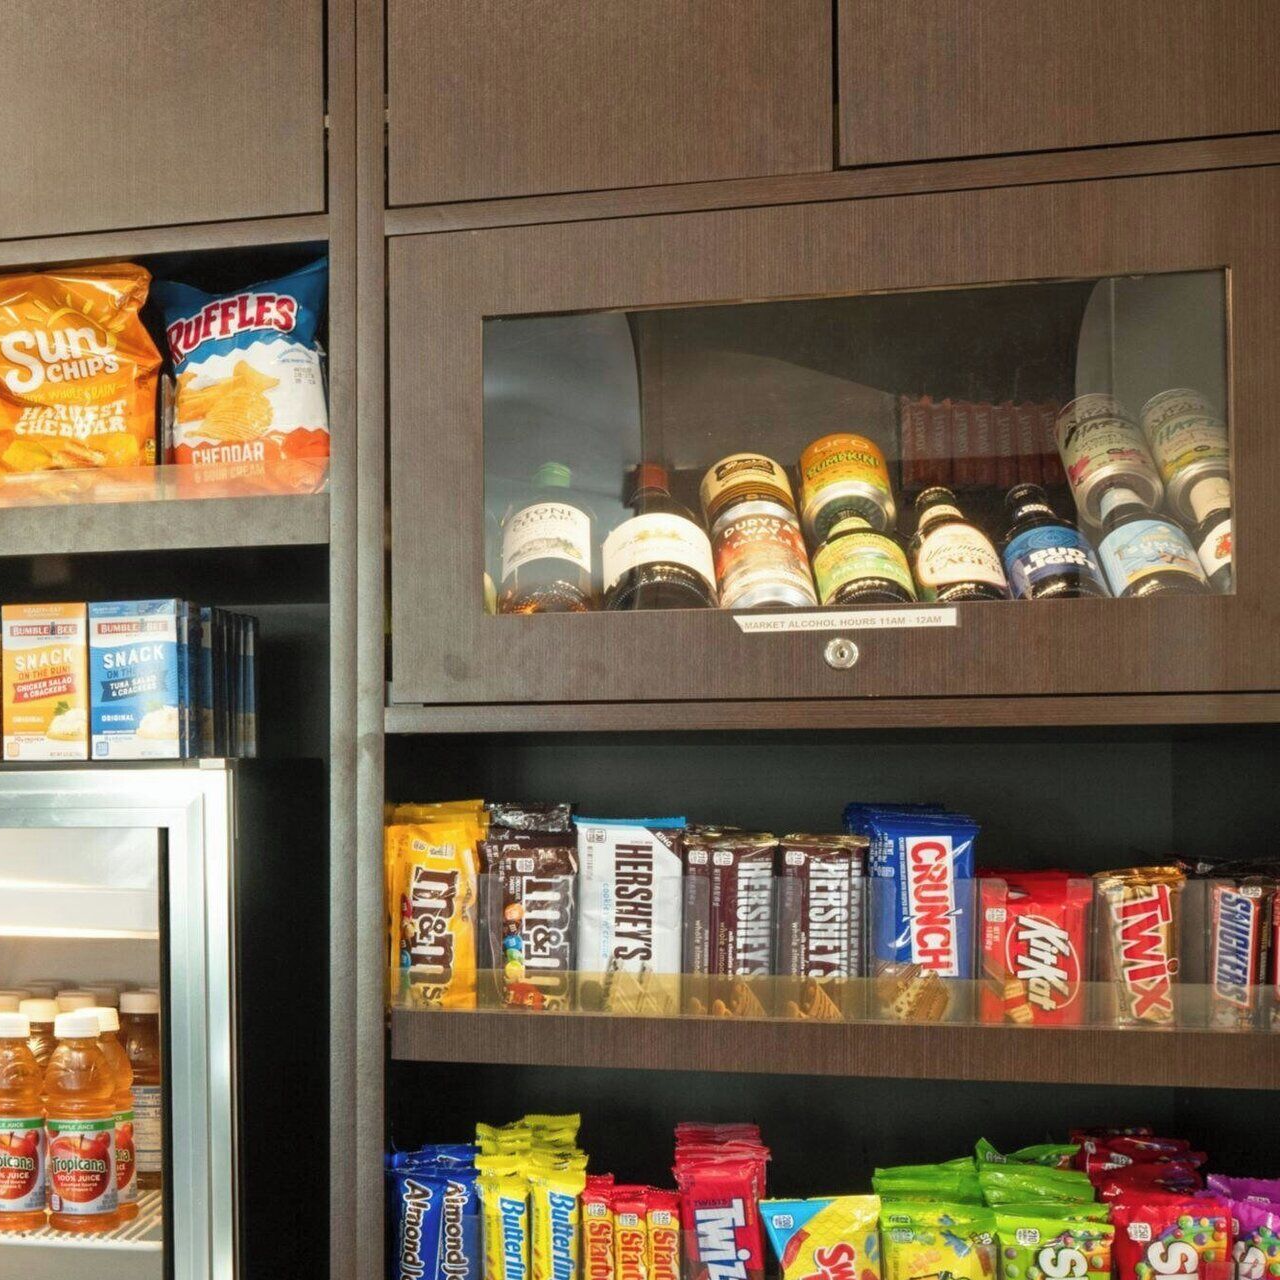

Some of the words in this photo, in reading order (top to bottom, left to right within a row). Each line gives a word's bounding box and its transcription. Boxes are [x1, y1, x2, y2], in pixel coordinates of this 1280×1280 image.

[167, 293, 299, 364] RUFFLES
[46, 354, 119, 383] CHIPS
[192, 441, 264, 466] CHEDDAR
[744, 621, 785, 629] MARKET
[789, 619, 836, 628] ALCOHOL
[840, 618, 876, 626] HOURS
[880, 616, 906, 625] 11AM
[915, 614, 942, 624] 12AM
[15, 649, 73, 672] SNACK
[104, 645, 164, 669] SNACK
[614, 844, 653, 961] HERSHEY'S
[910, 840, 954, 976] CRUNCH
[1214, 891, 1255, 1006] SNICKERS
[7, 1171, 30, 1180] JUICE
[52, 1158, 105, 1173] Tropicana
[81, 1173, 100, 1181] JUICE
[442, 1180, 468, 1262] Almond
